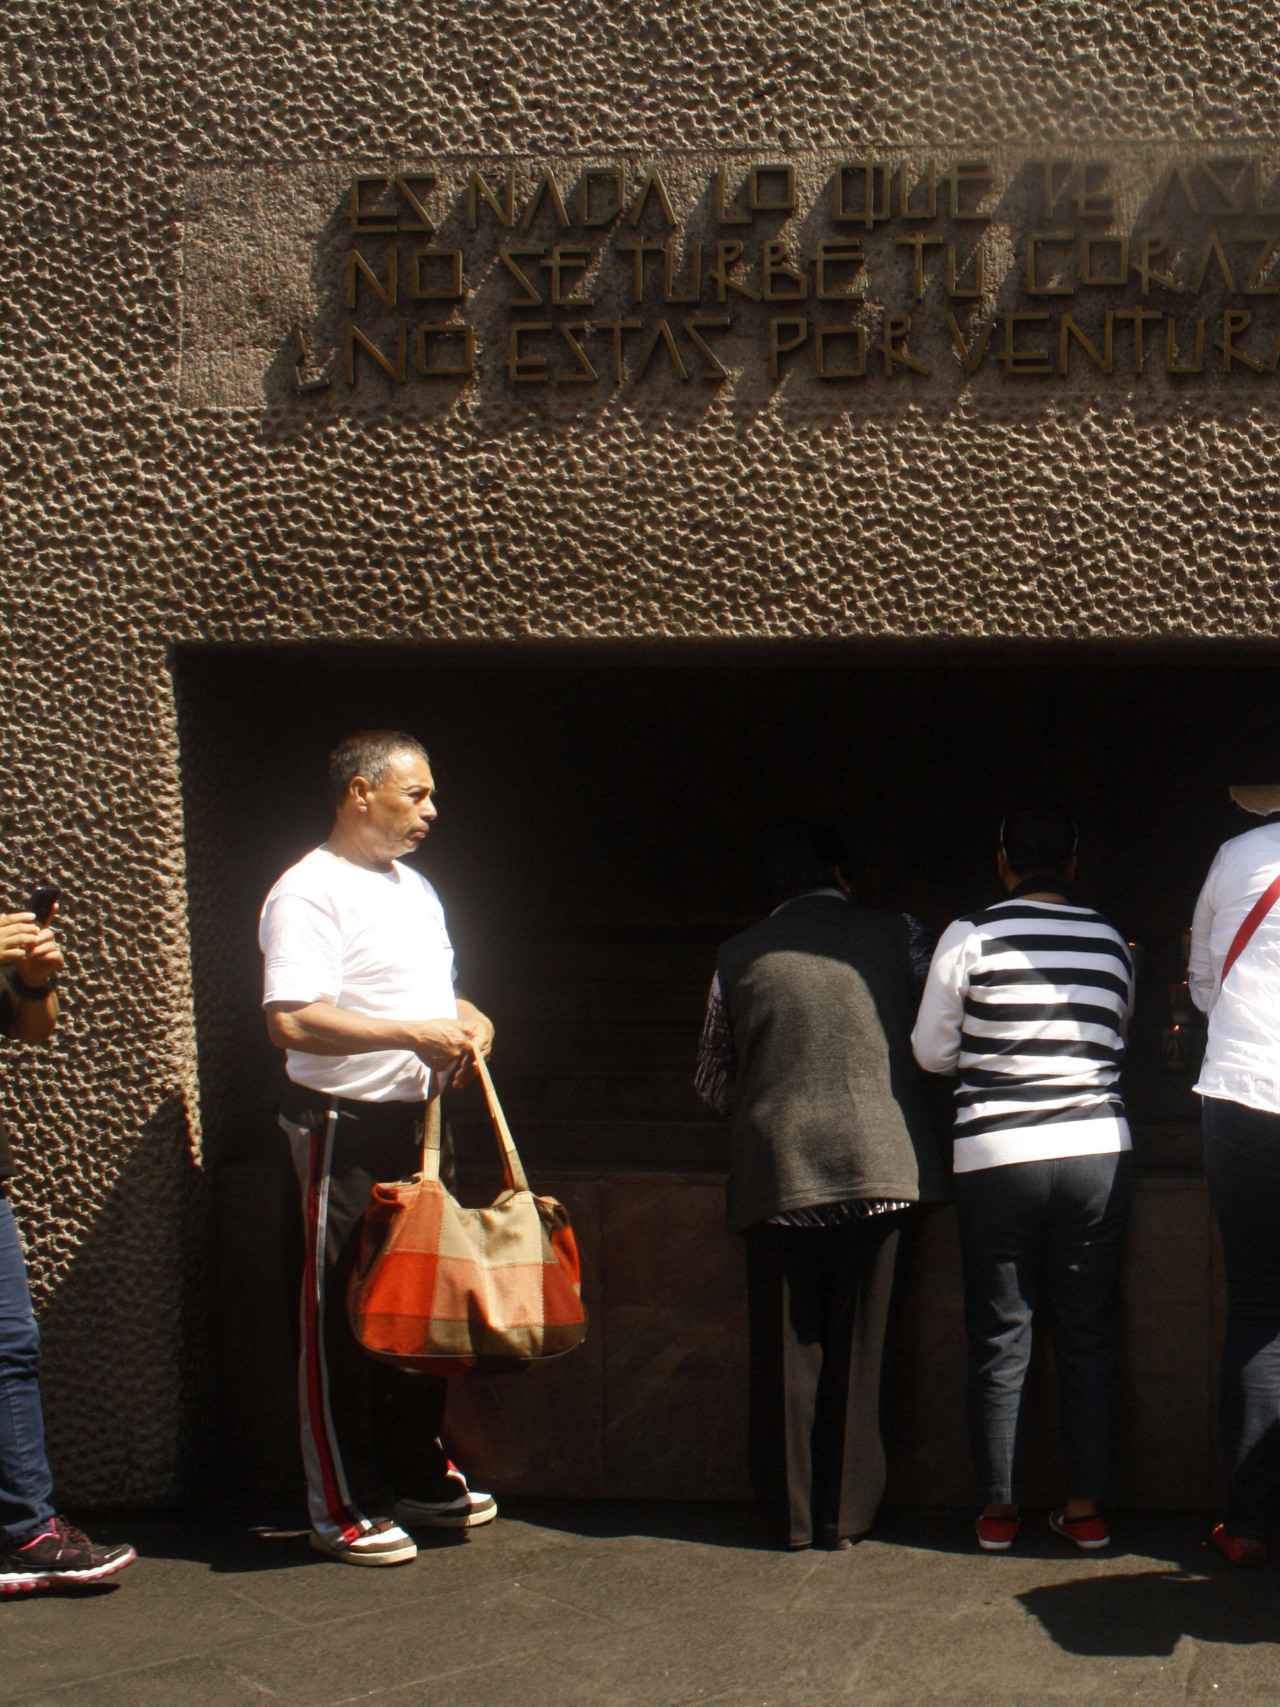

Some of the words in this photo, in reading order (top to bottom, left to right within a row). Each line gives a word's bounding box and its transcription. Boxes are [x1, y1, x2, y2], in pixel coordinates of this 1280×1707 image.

[349, 171, 436, 233] ES
[465, 167, 678, 231] NADA
[717, 163, 796, 224] LO
[834, 152, 994, 230] QUE
[1022, 157, 1115, 217] TE
[349, 246, 463, 310] NO
[500, 245, 595, 306] SE
[614, 235, 868, 302] TURBE
[893, 231, 985, 300] TU
[502, 315, 731, 384] ESTAS
[770, 313, 931, 380] POR
